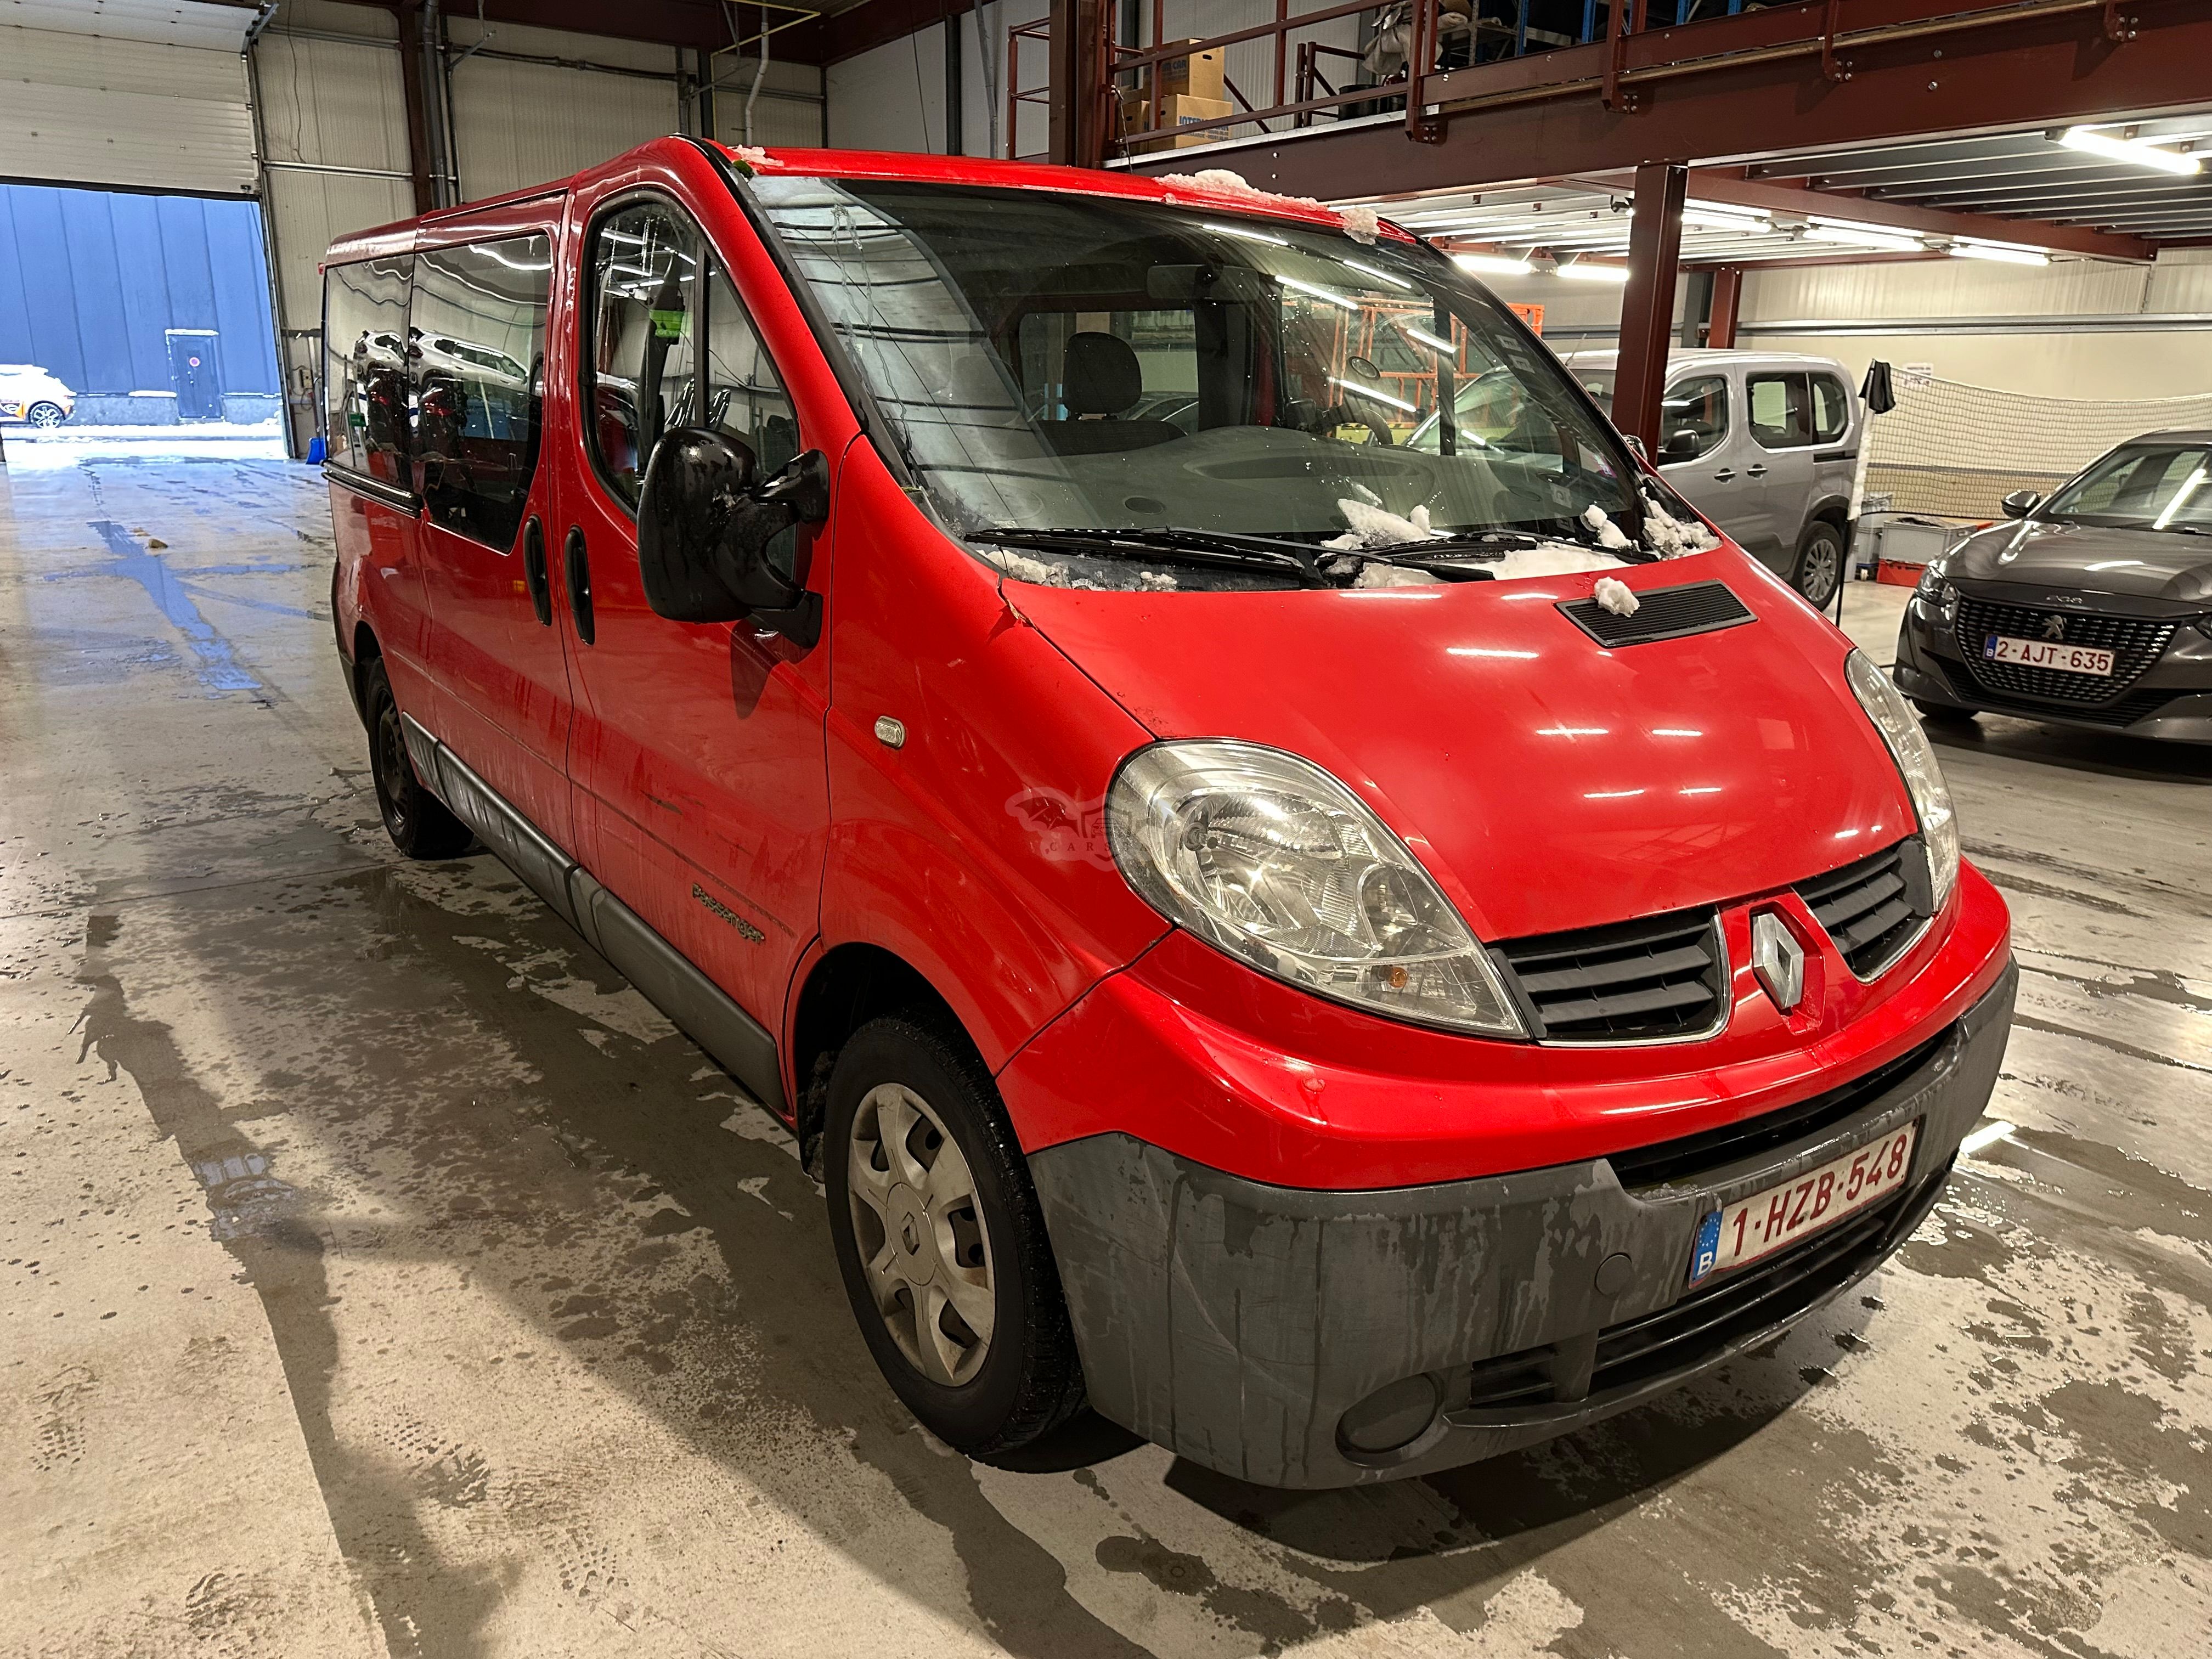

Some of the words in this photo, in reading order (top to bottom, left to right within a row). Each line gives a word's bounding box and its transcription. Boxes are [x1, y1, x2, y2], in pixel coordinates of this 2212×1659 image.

[1985, 647, 1995, 658] B
[1996, 641, 2111, 672] 2-AJT-635
[692, 882, 766, 945] Passenger
[1697, 1251, 1713, 1277] B
[1733, 1133, 1908, 1257] 1-HZB-548
